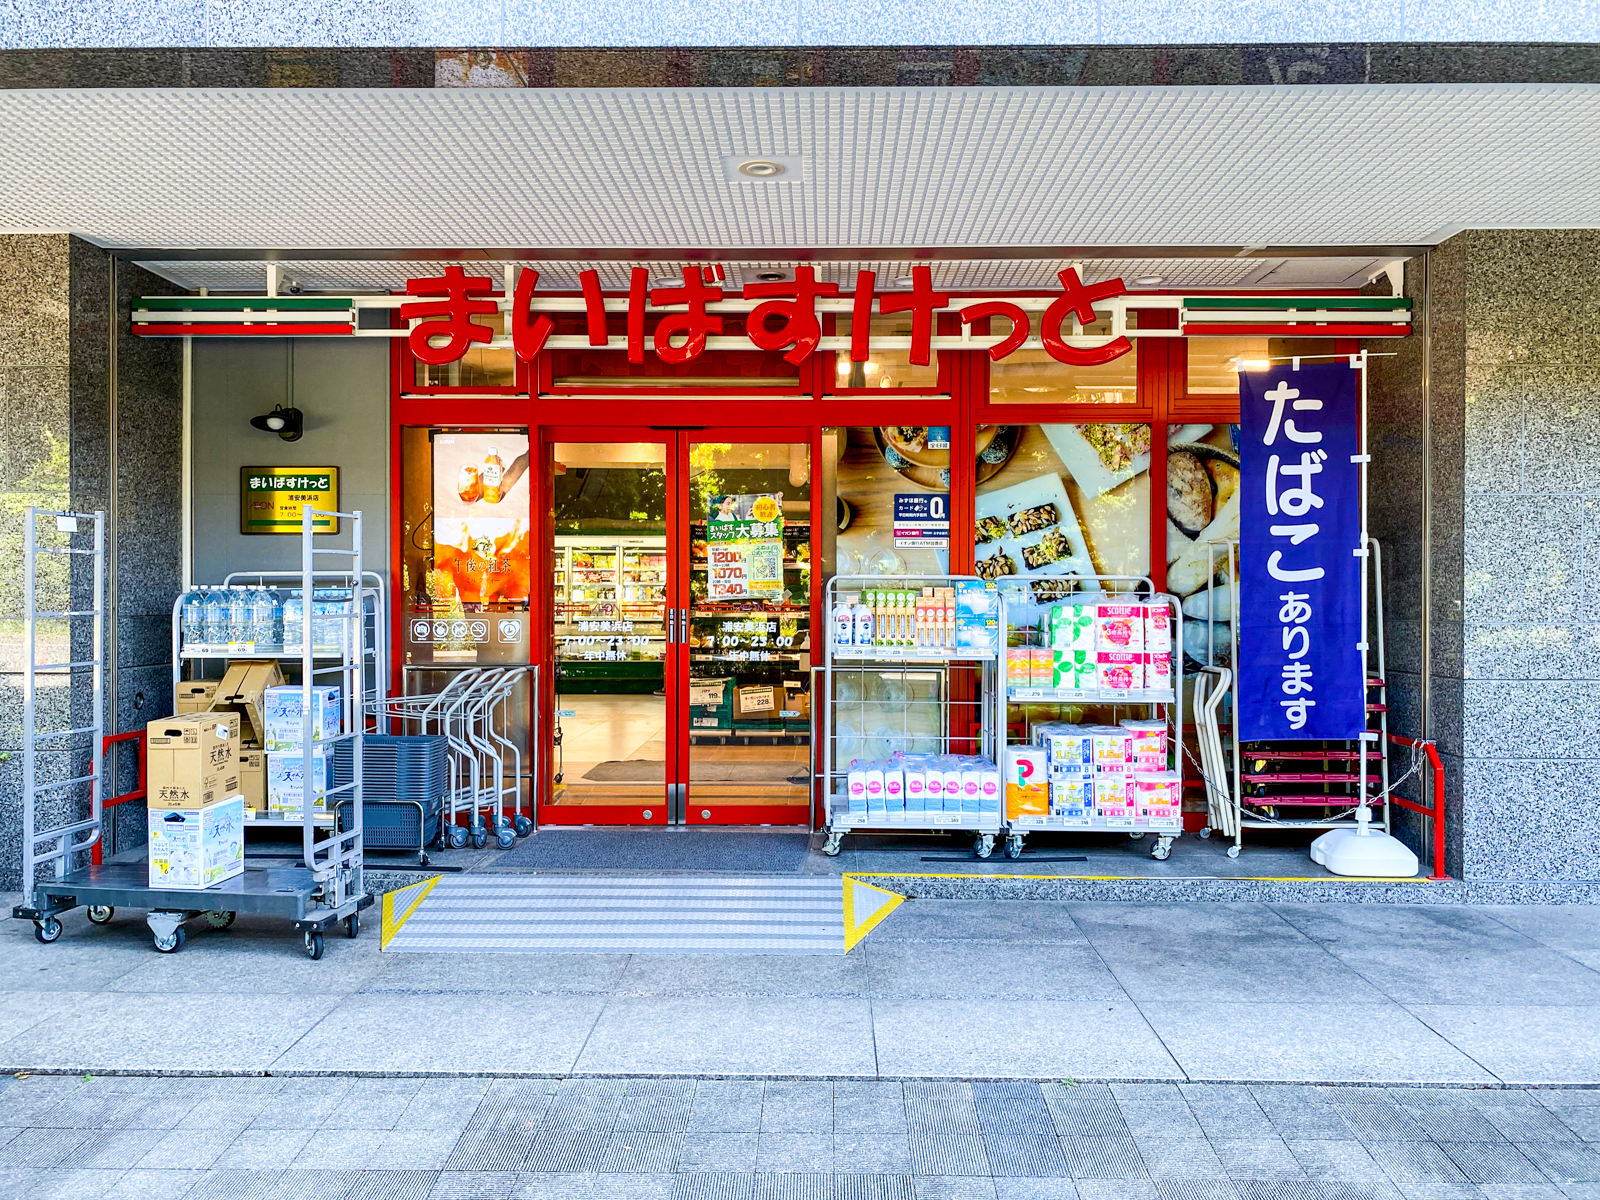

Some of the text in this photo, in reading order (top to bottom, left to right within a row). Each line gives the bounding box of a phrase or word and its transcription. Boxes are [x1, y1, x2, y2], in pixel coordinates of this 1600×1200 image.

[400, 265, 1133, 366] まいばすけっと
[249, 476, 329, 489] まいばすけっと
[287, 494, 319, 502] 浦安美浜店
[709, 531, 735, 540] スタッフ
[735, 521, 779, 539] 大募集
[454, 557, 512, 574] 午後の紅茶
[1106, 606, 1132, 615] scottie
[578, 620, 634, 632] 浦安美浜店
[722, 621, 778, 633] 浦安美浜店
[583, 650, 628, 662] 年中無休
[728, 650, 771, 662] 年中無休
[1108, 652, 1133, 661] scottie
[756, 698, 770, 706] 228
[209, 745, 233, 765] 天然水
[158, 789, 190, 800] 天然水
